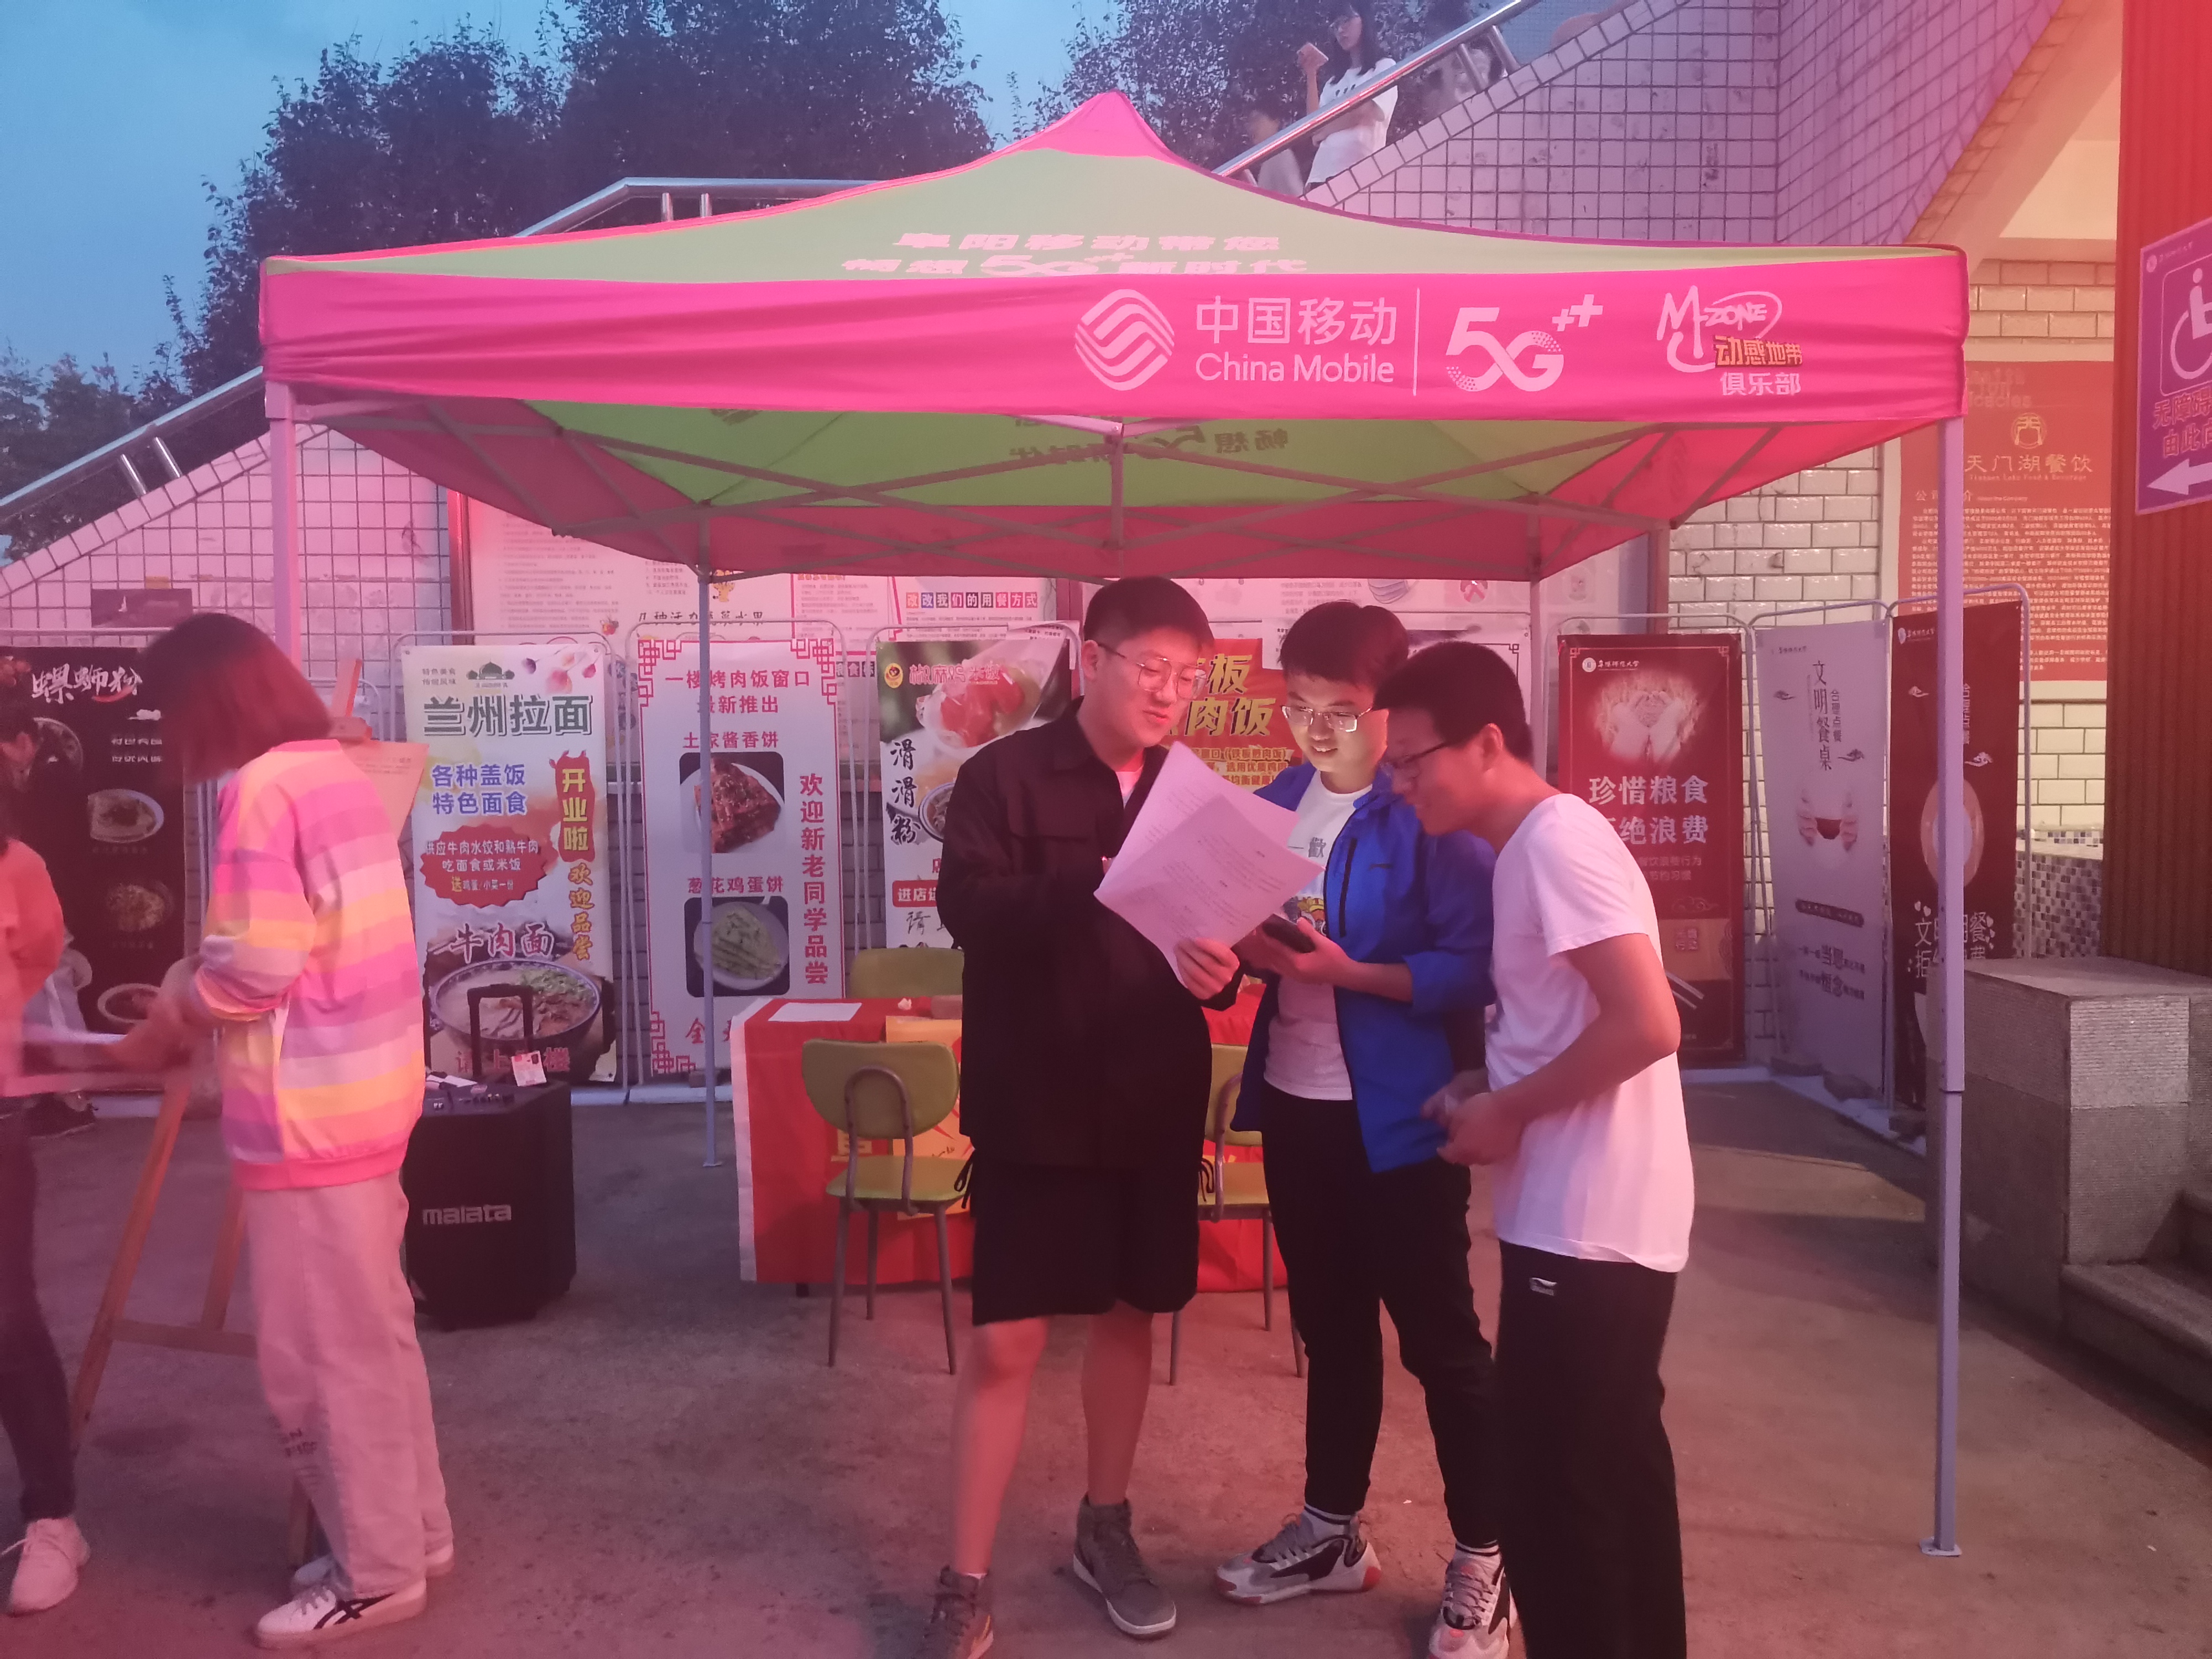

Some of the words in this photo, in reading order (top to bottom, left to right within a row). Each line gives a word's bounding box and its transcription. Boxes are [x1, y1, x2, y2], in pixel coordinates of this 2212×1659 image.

[1196, 295, 1396, 345] 中国移动
[1713, 335, 1803, 367] 动感地带
[1196, 352, 1284, 382] China
[1294, 352, 1394, 383] Mobile
[1720, 372, 1802, 397] 俱乐部
[1964, 453, 2093, 473] 天门湖餐饮
[906, 592, 1038, 608] 改改我们的用餐方式
[665, 670, 810, 689] 一楼烤肉饭窗口
[1197, 654, 1253, 694] 板
[424, 695, 593, 737] 兰州拉面
[1168, 697, 1276, 736] 肉饭
[1813, 660, 1832, 771] 文明餐桌
[432, 764, 525, 787] 各种盖饭
[1589, 775, 1708, 805] 珍惜粮食
[432, 791, 526, 815] 特色面食
[562, 769, 588, 851] 开业啦
[1610, 815, 1708, 844] 绝浪费
[426, 840, 539, 855] 供应牛肉水饺和熟牛肉
[442, 858, 520, 872] 吃面食或米饭
[800, 773, 828, 984] 欢迎新老同学品尝
[688, 876, 783, 894] 葱花鸡蛋饼
[568, 862, 594, 961] 欢迎品尝
[449, 923, 555, 963] 牛肉面
[422, 1204, 512, 1225] malata
